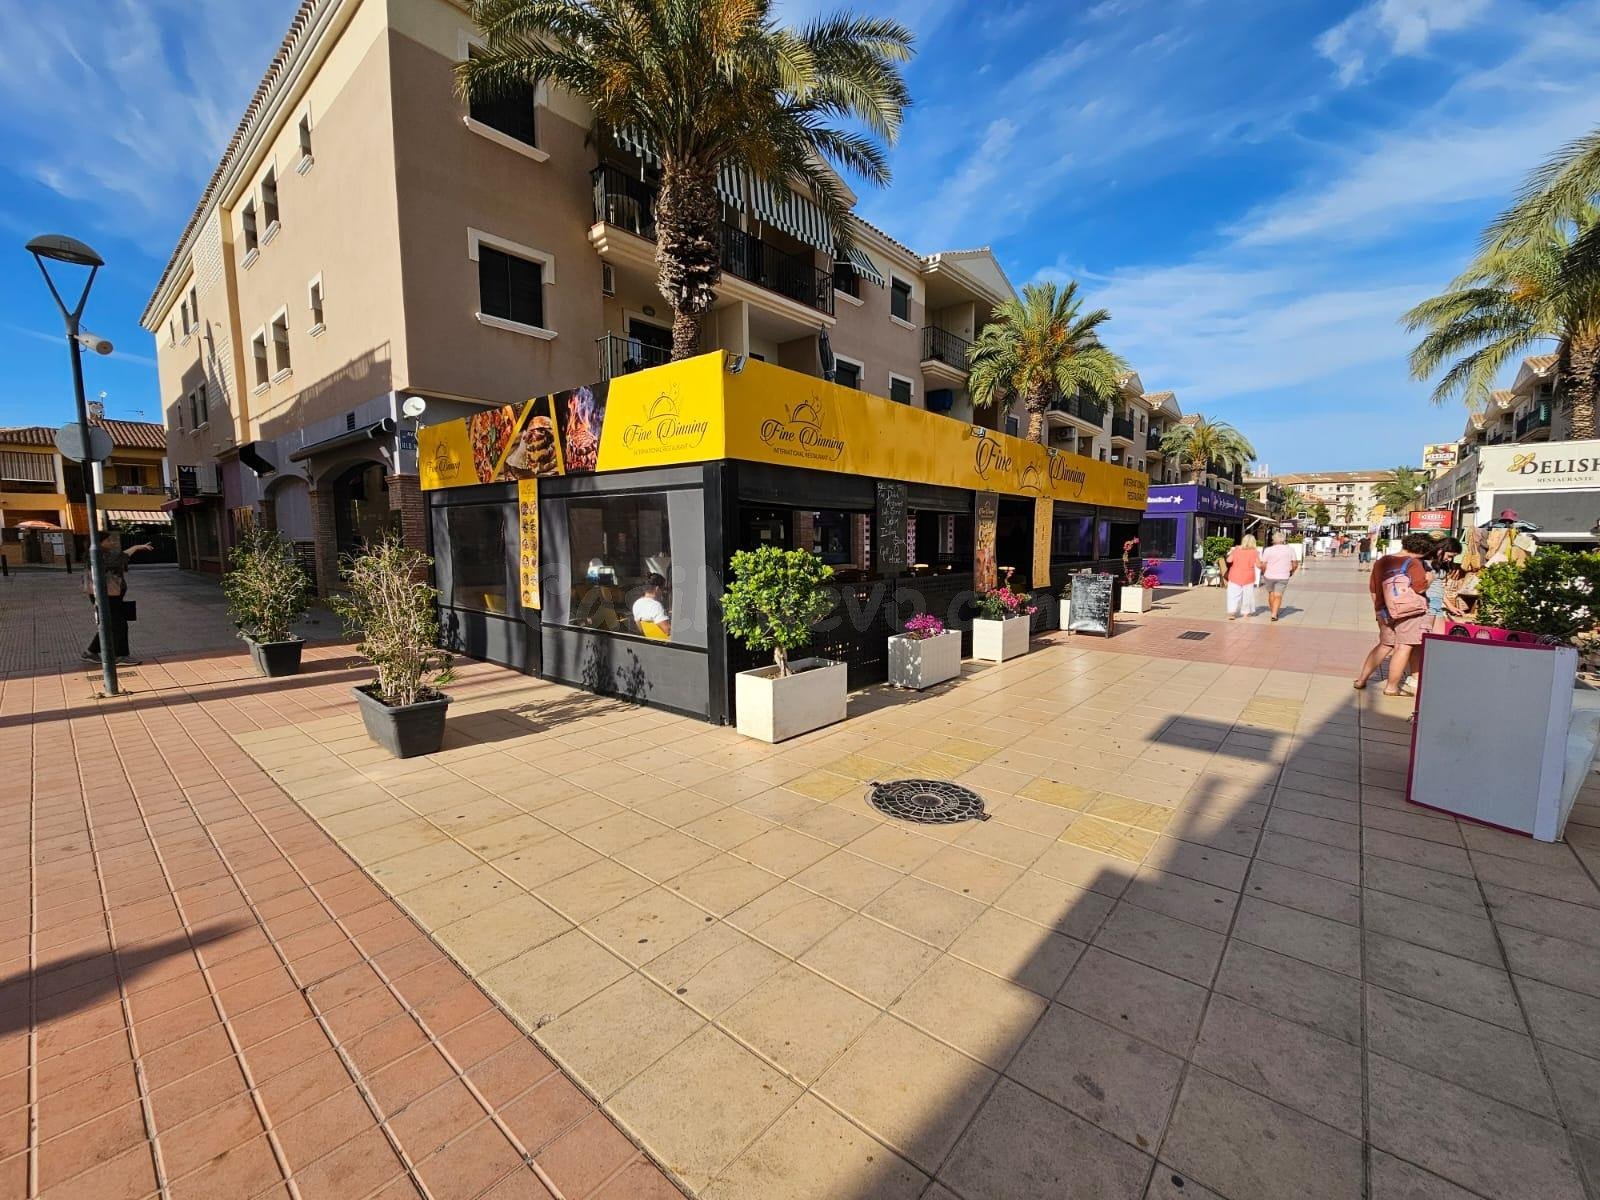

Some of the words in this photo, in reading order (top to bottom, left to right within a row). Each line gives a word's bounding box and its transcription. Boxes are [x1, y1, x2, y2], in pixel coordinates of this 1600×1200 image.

[622, 424, 653, 450] Fine
[656, 418, 709, 449] Dinning
[760, 418, 795, 447] Fine
[799, 426, 845, 462] Dinning
[774, 447, 805, 458] INTERNATIONAL
[974, 437, 1012, 481] Fine
[1048, 453, 1086, 498] Dinning
[1537, 476, 1594, 484] RESTAURANTE
